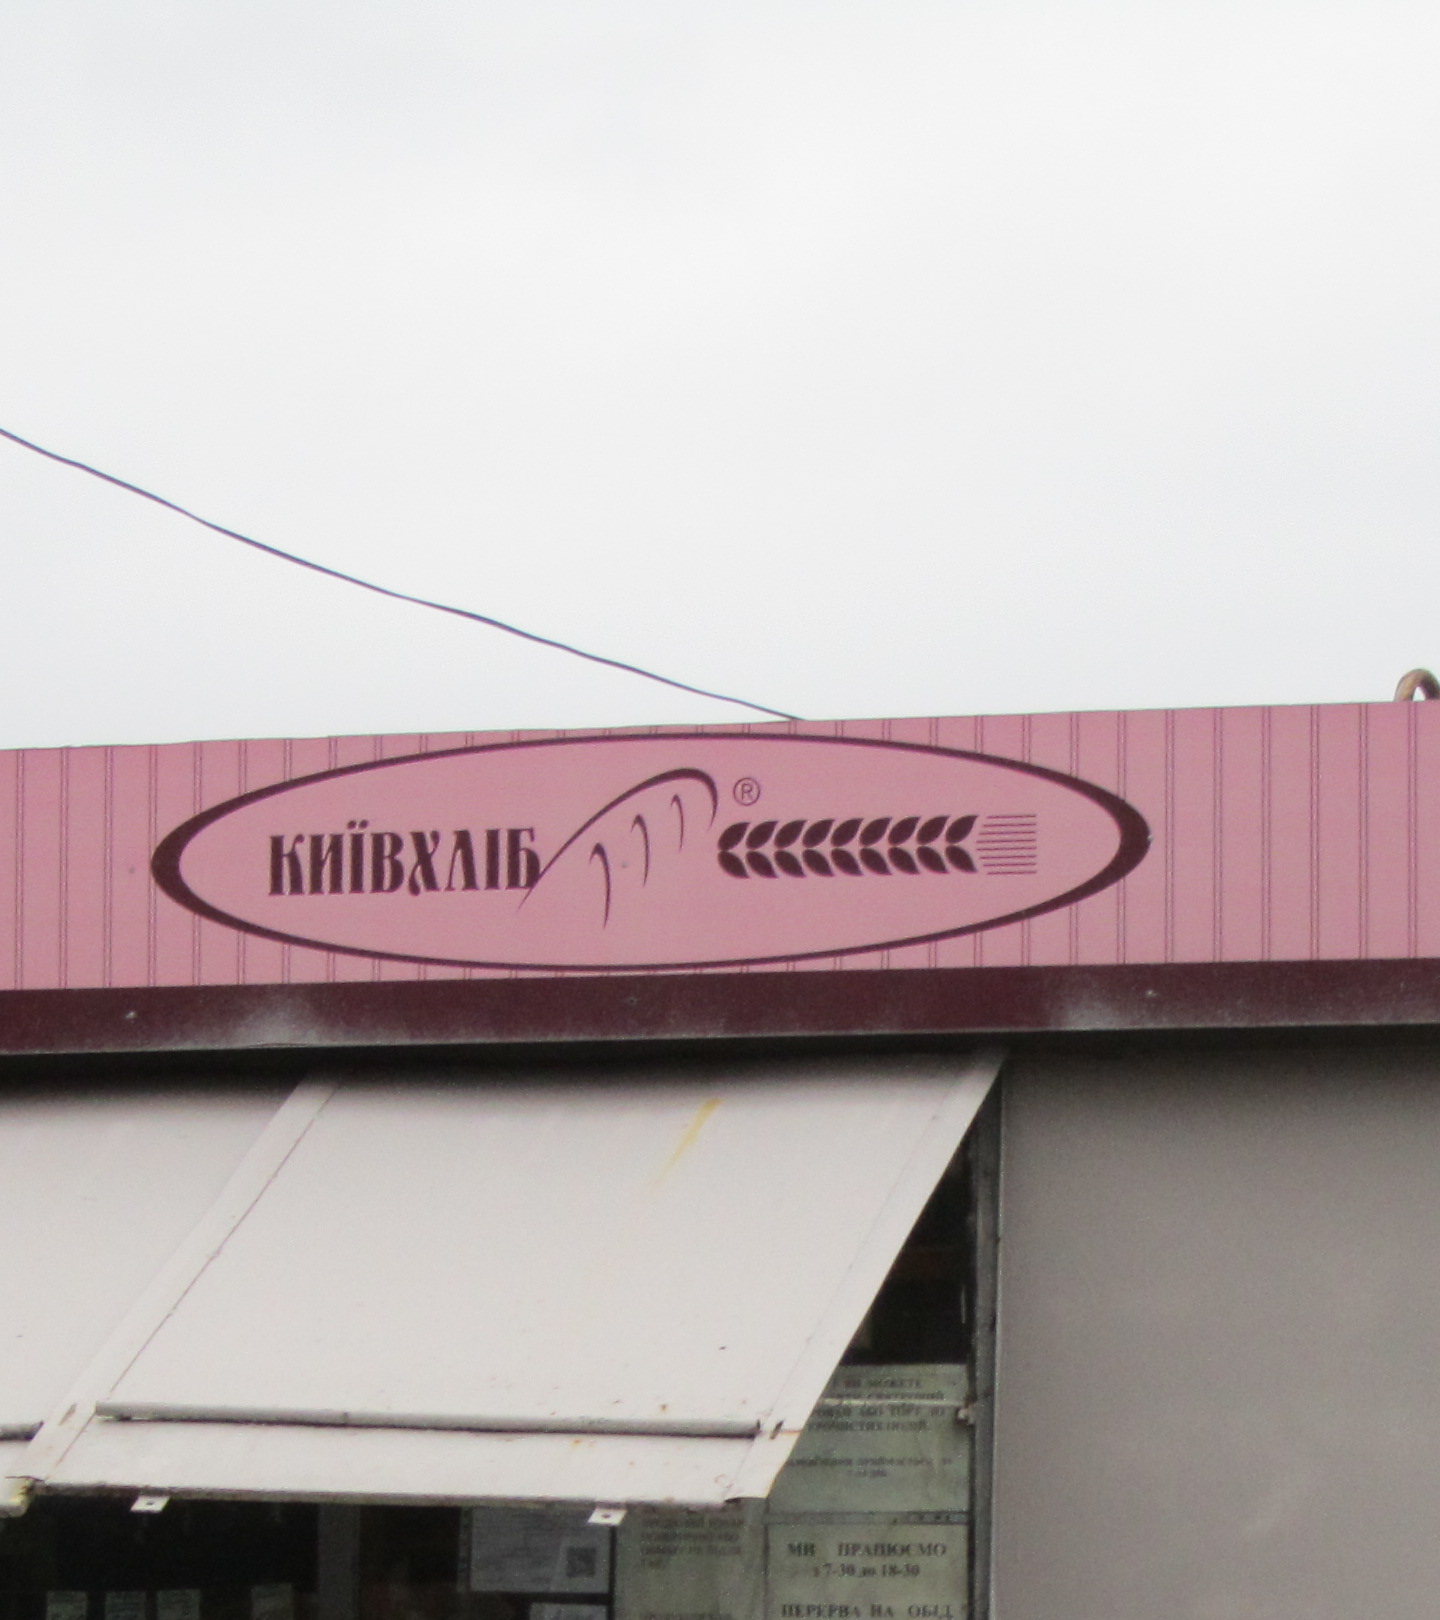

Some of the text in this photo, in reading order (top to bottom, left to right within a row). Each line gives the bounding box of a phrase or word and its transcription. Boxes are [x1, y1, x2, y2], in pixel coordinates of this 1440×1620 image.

[269, 820, 541, 897] КИЇВХЛІБ
[787, 1541, 816, 1557] МИ
[780, 1603, 955, 1620] ПЕРЕРВА НА ОБІД
